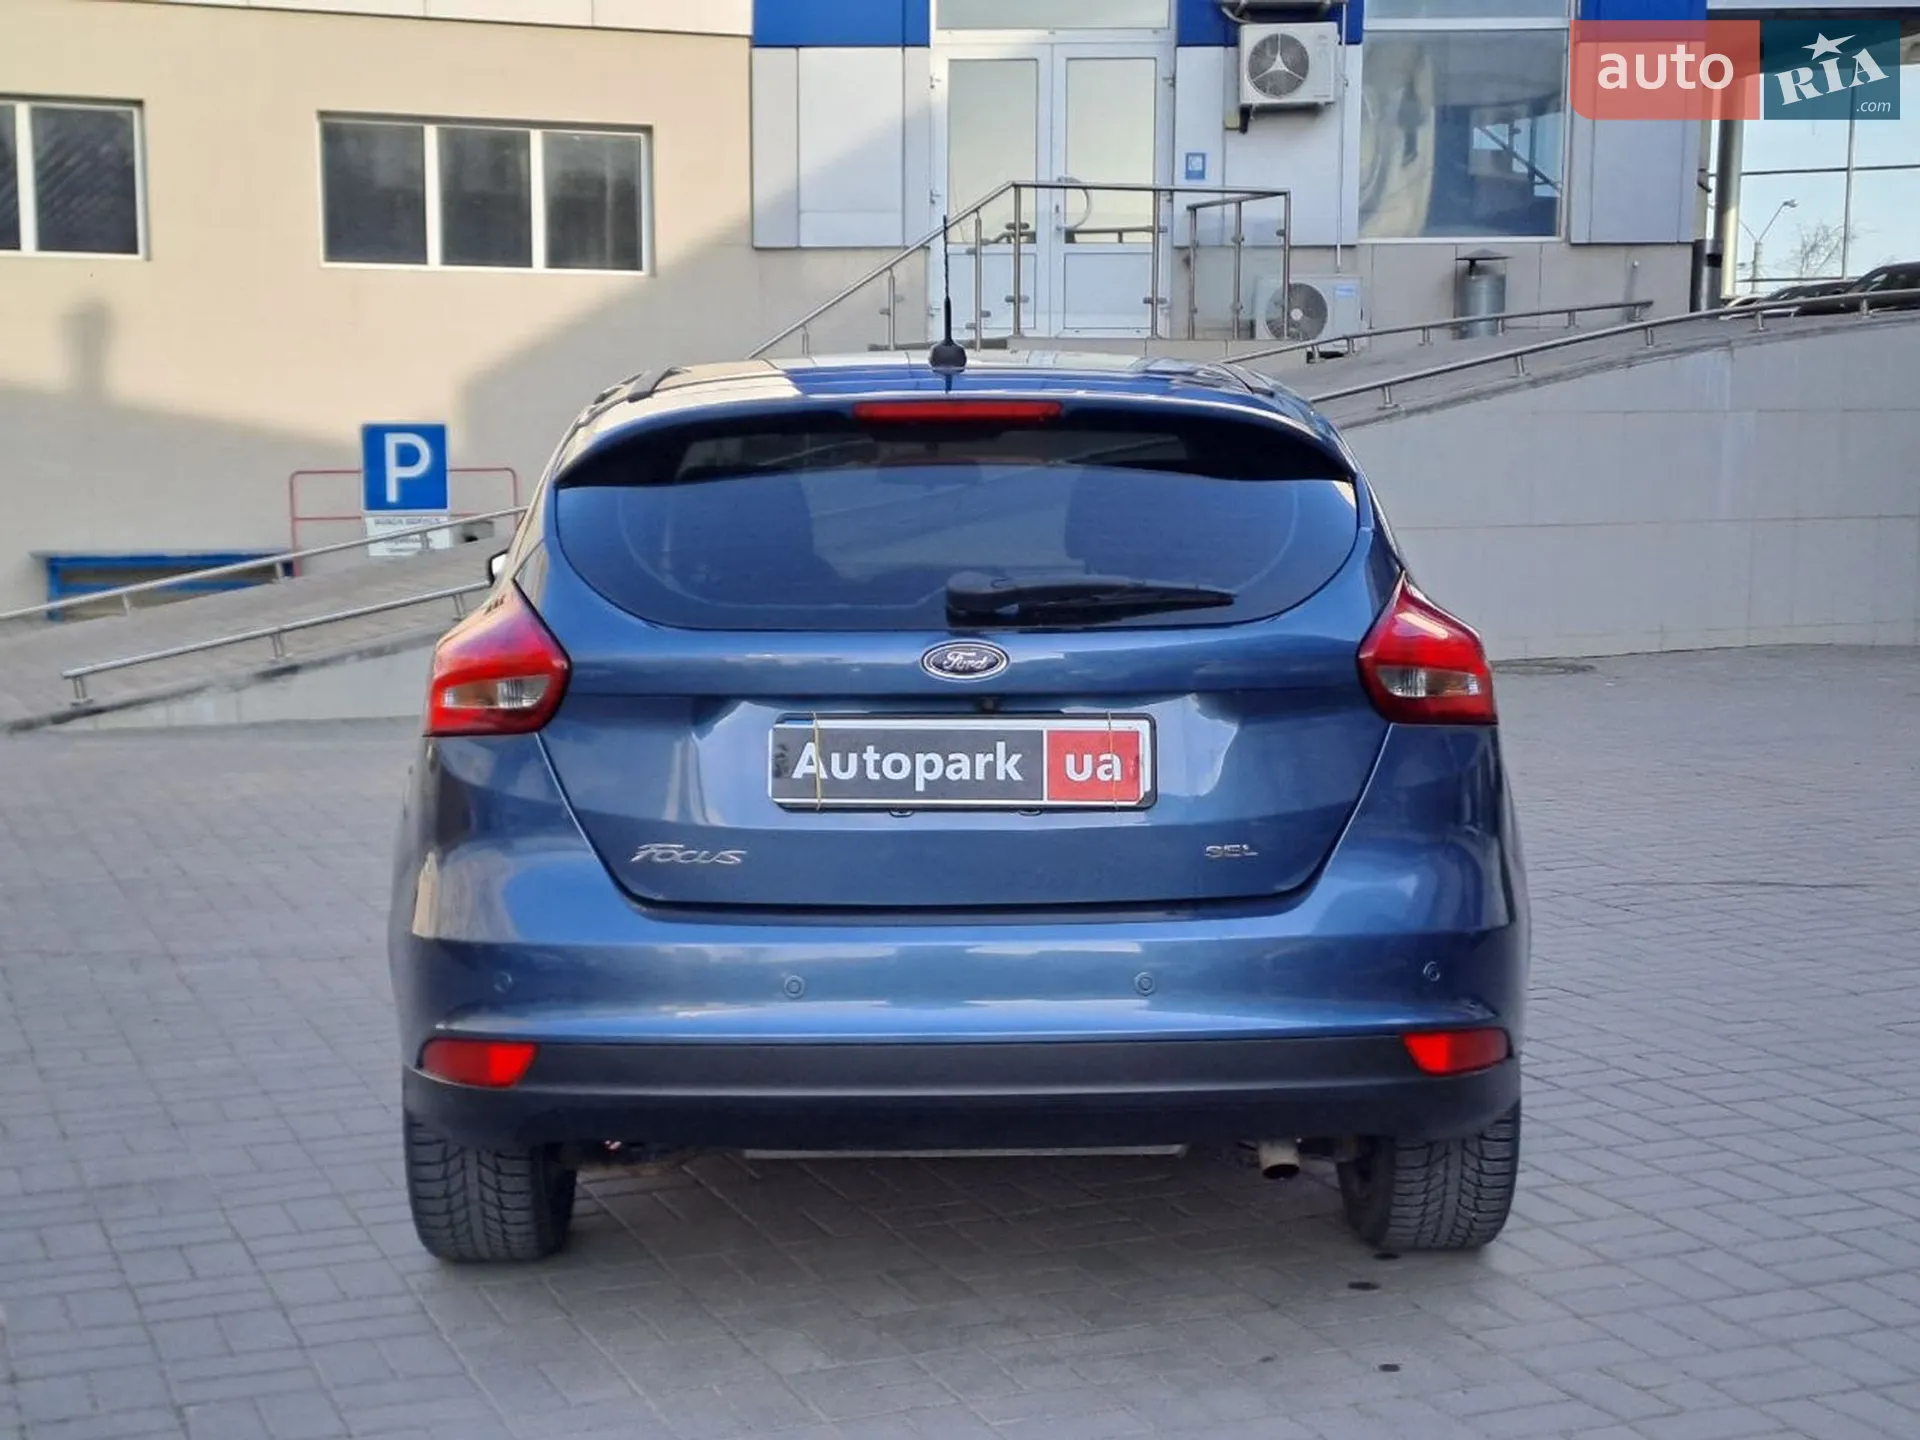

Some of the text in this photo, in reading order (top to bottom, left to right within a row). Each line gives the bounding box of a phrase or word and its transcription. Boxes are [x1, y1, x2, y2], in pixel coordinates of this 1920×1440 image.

[384, 432, 431, 503] P
[943, 651, 988, 671] Ford
[791, 741, 1122, 792] Autopark ua
[1204, 844, 1258, 858] SEL
